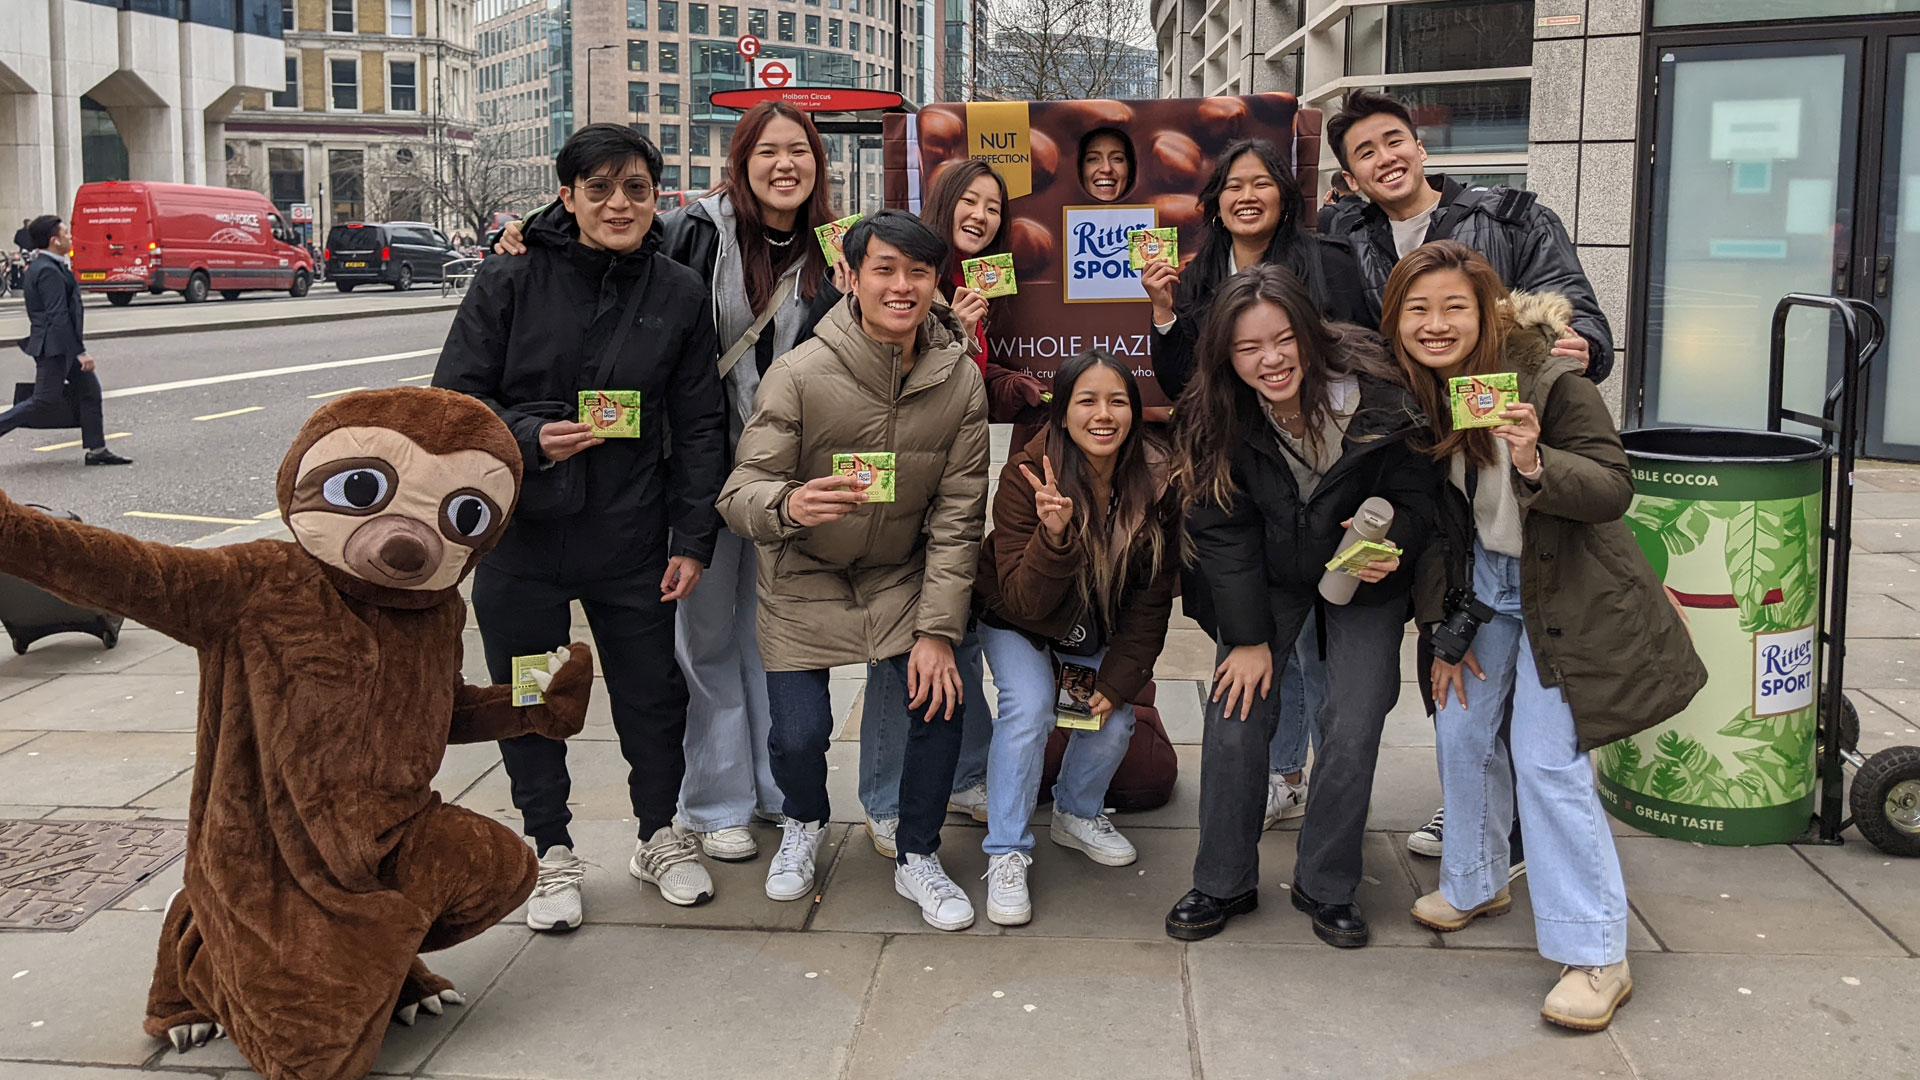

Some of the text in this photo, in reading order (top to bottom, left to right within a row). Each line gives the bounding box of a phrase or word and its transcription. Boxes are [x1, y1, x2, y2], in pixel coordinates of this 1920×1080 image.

[740, 37, 756, 55] G
[980, 132, 1017, 149] NUT
[971, 153, 1029, 164] PERFECTION
[1072, 259, 1144, 279] SPOR
[989, 336, 1082, 358] WHOLE
[1036, 370, 1057, 379] cru
[1663, 473, 1719, 486] COCOA
[1761, 639, 1812, 677] Ritter
[1760, 670, 1812, 697] SPORT
[1635, 804, 1678, 825] GREAT
[1680, 815, 1724, 831] TASTE
